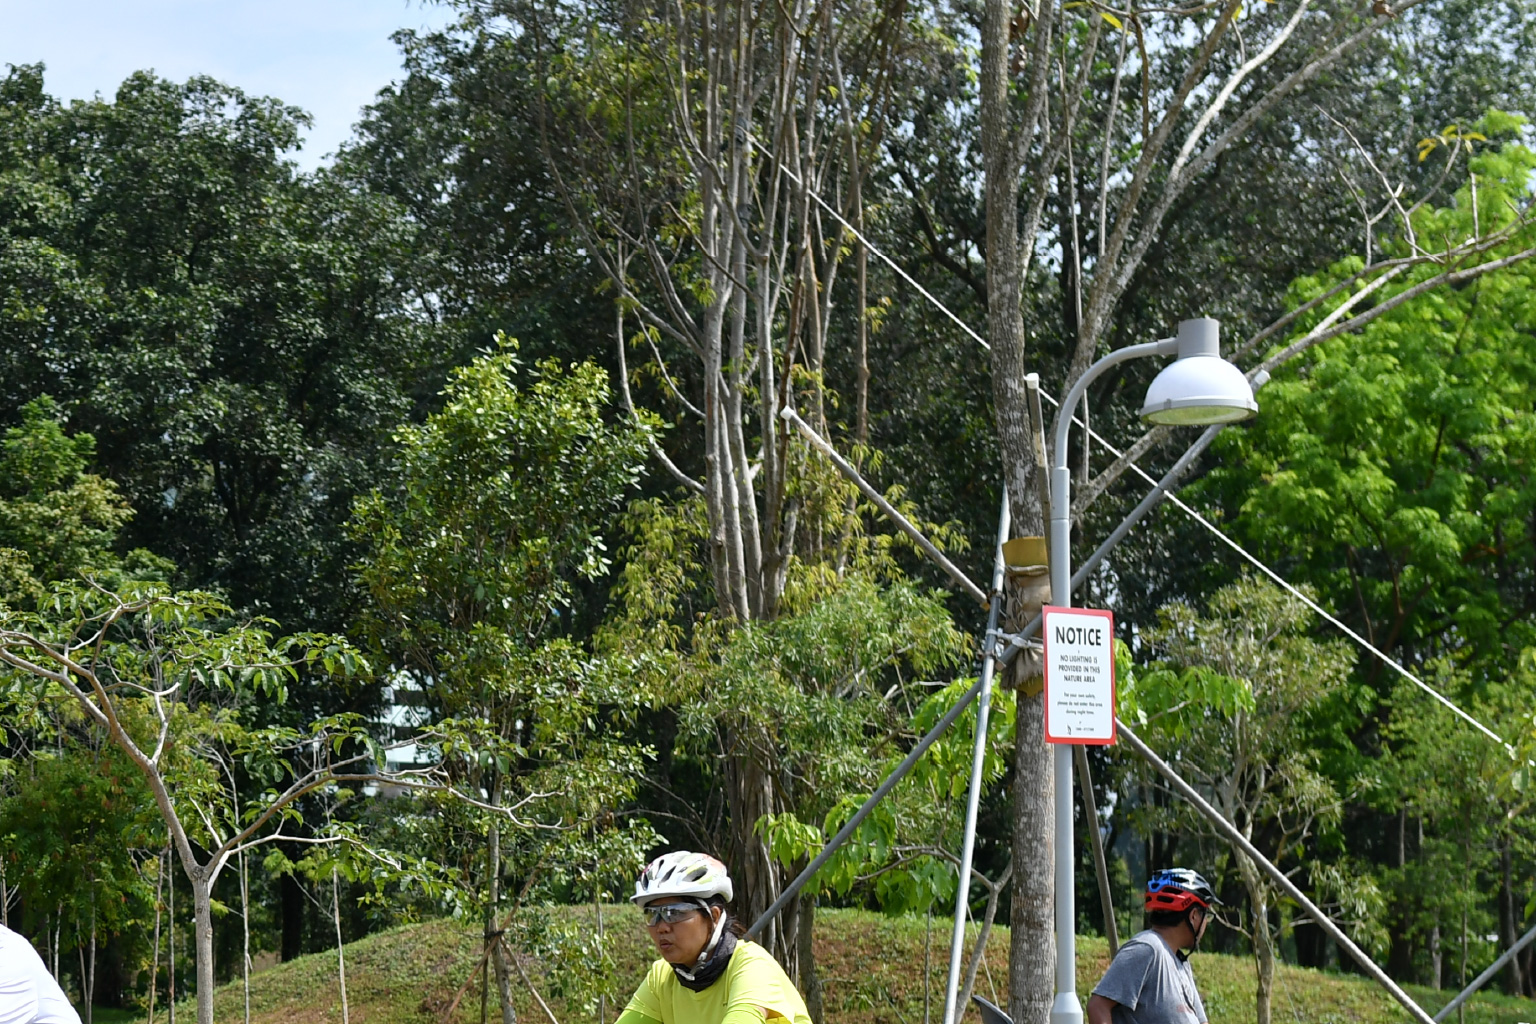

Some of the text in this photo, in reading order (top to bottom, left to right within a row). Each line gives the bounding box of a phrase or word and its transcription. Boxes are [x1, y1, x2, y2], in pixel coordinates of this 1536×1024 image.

[1055, 625, 1102, 646] NOTICE
[1060, 654, 1098, 664] NO LIGHTING IS
[1058, 664, 1100, 674] PROVIDED IN THIS
[1063, 674, 1096, 683] NATURE AREA
